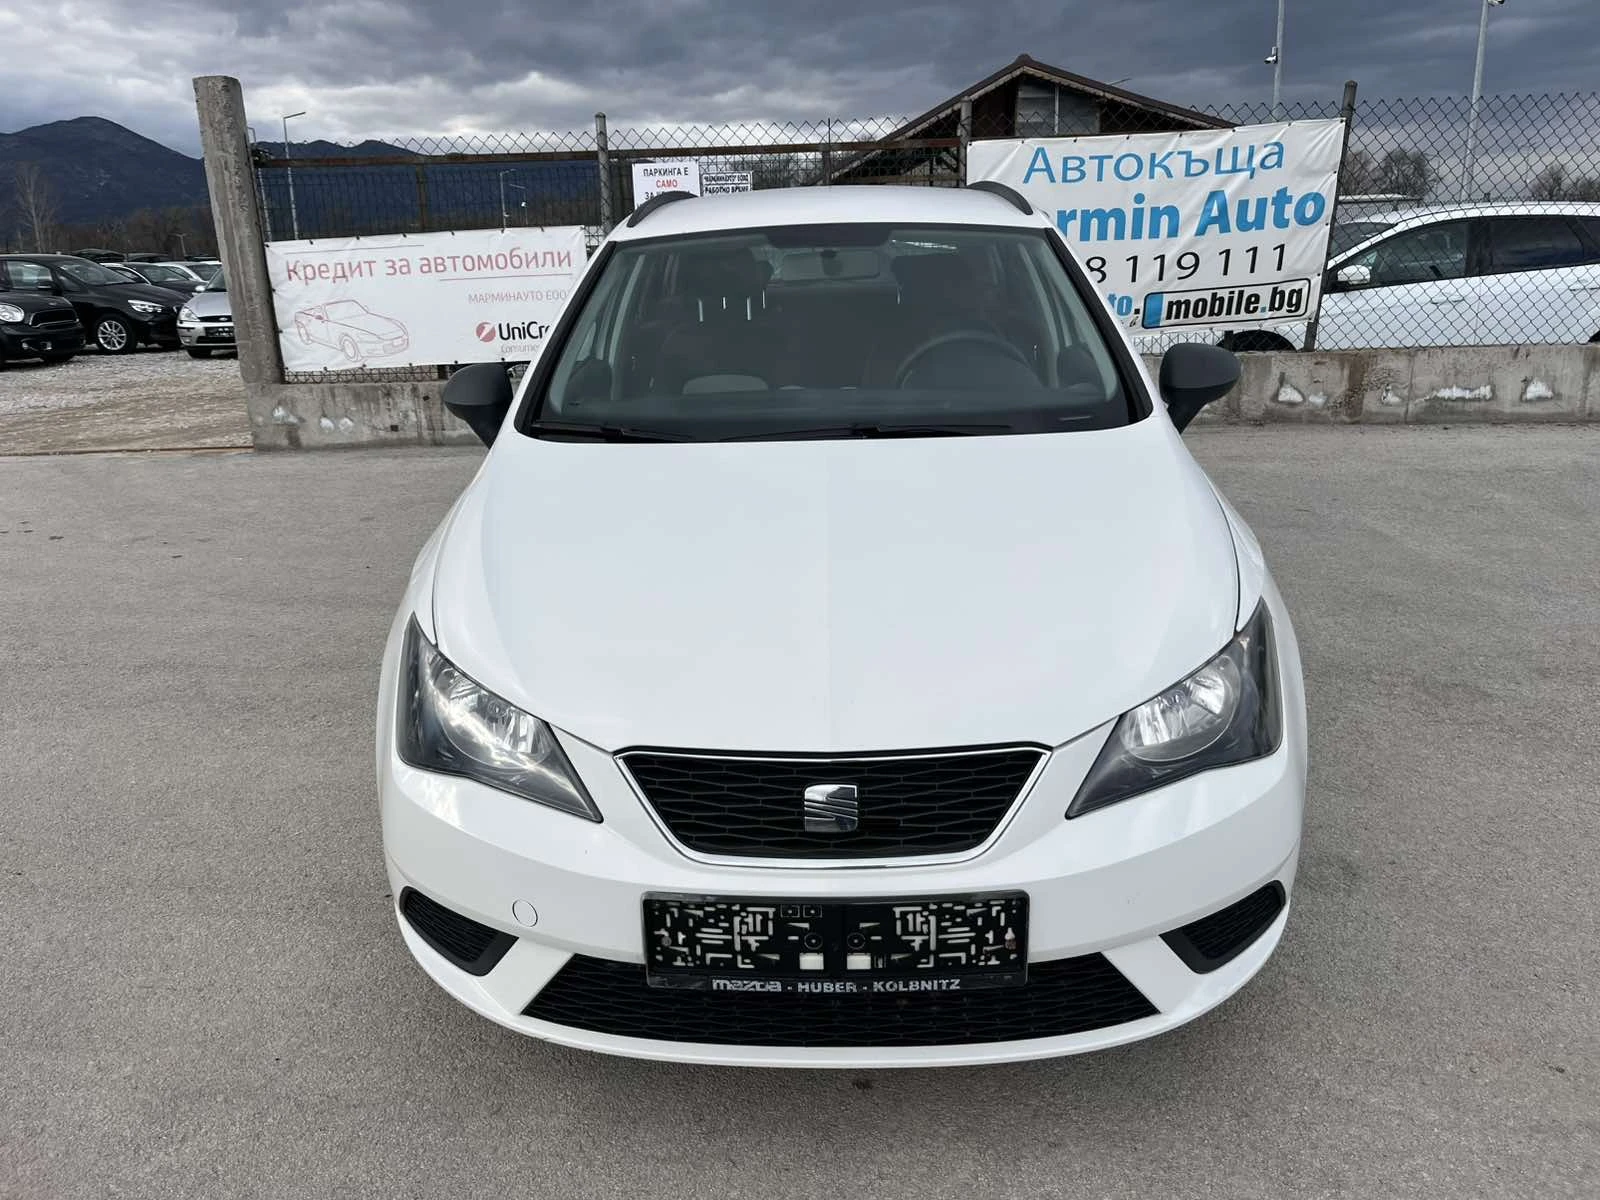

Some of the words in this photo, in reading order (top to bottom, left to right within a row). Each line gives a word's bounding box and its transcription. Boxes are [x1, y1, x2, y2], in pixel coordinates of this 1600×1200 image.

[643, 167, 682, 177] ПАРКИНГА
[1022, 140, 1285, 185] Автокъща
[656, 179, 678, 188] САМО
[1055, 192, 1181, 242] rmin
[1193, 186, 1326, 237] Auto
[286, 260, 377, 284] Кредит
[384, 257, 411, 276] за
[419, 246, 573, 274] автомобили
[1085, 255, 1107, 284] 8
[1125, 251, 1200, 283] 119
[1218, 243, 1287, 277] 111
[467, 291, 544, 304] МАРМИНАУТО
[546, 289, 570, 301] ЕОО
[1164, 285, 1304, 322] mobile.bg
[498, 321, 550, 341] UniCr
[797, 982, 857, 993] HUBER
